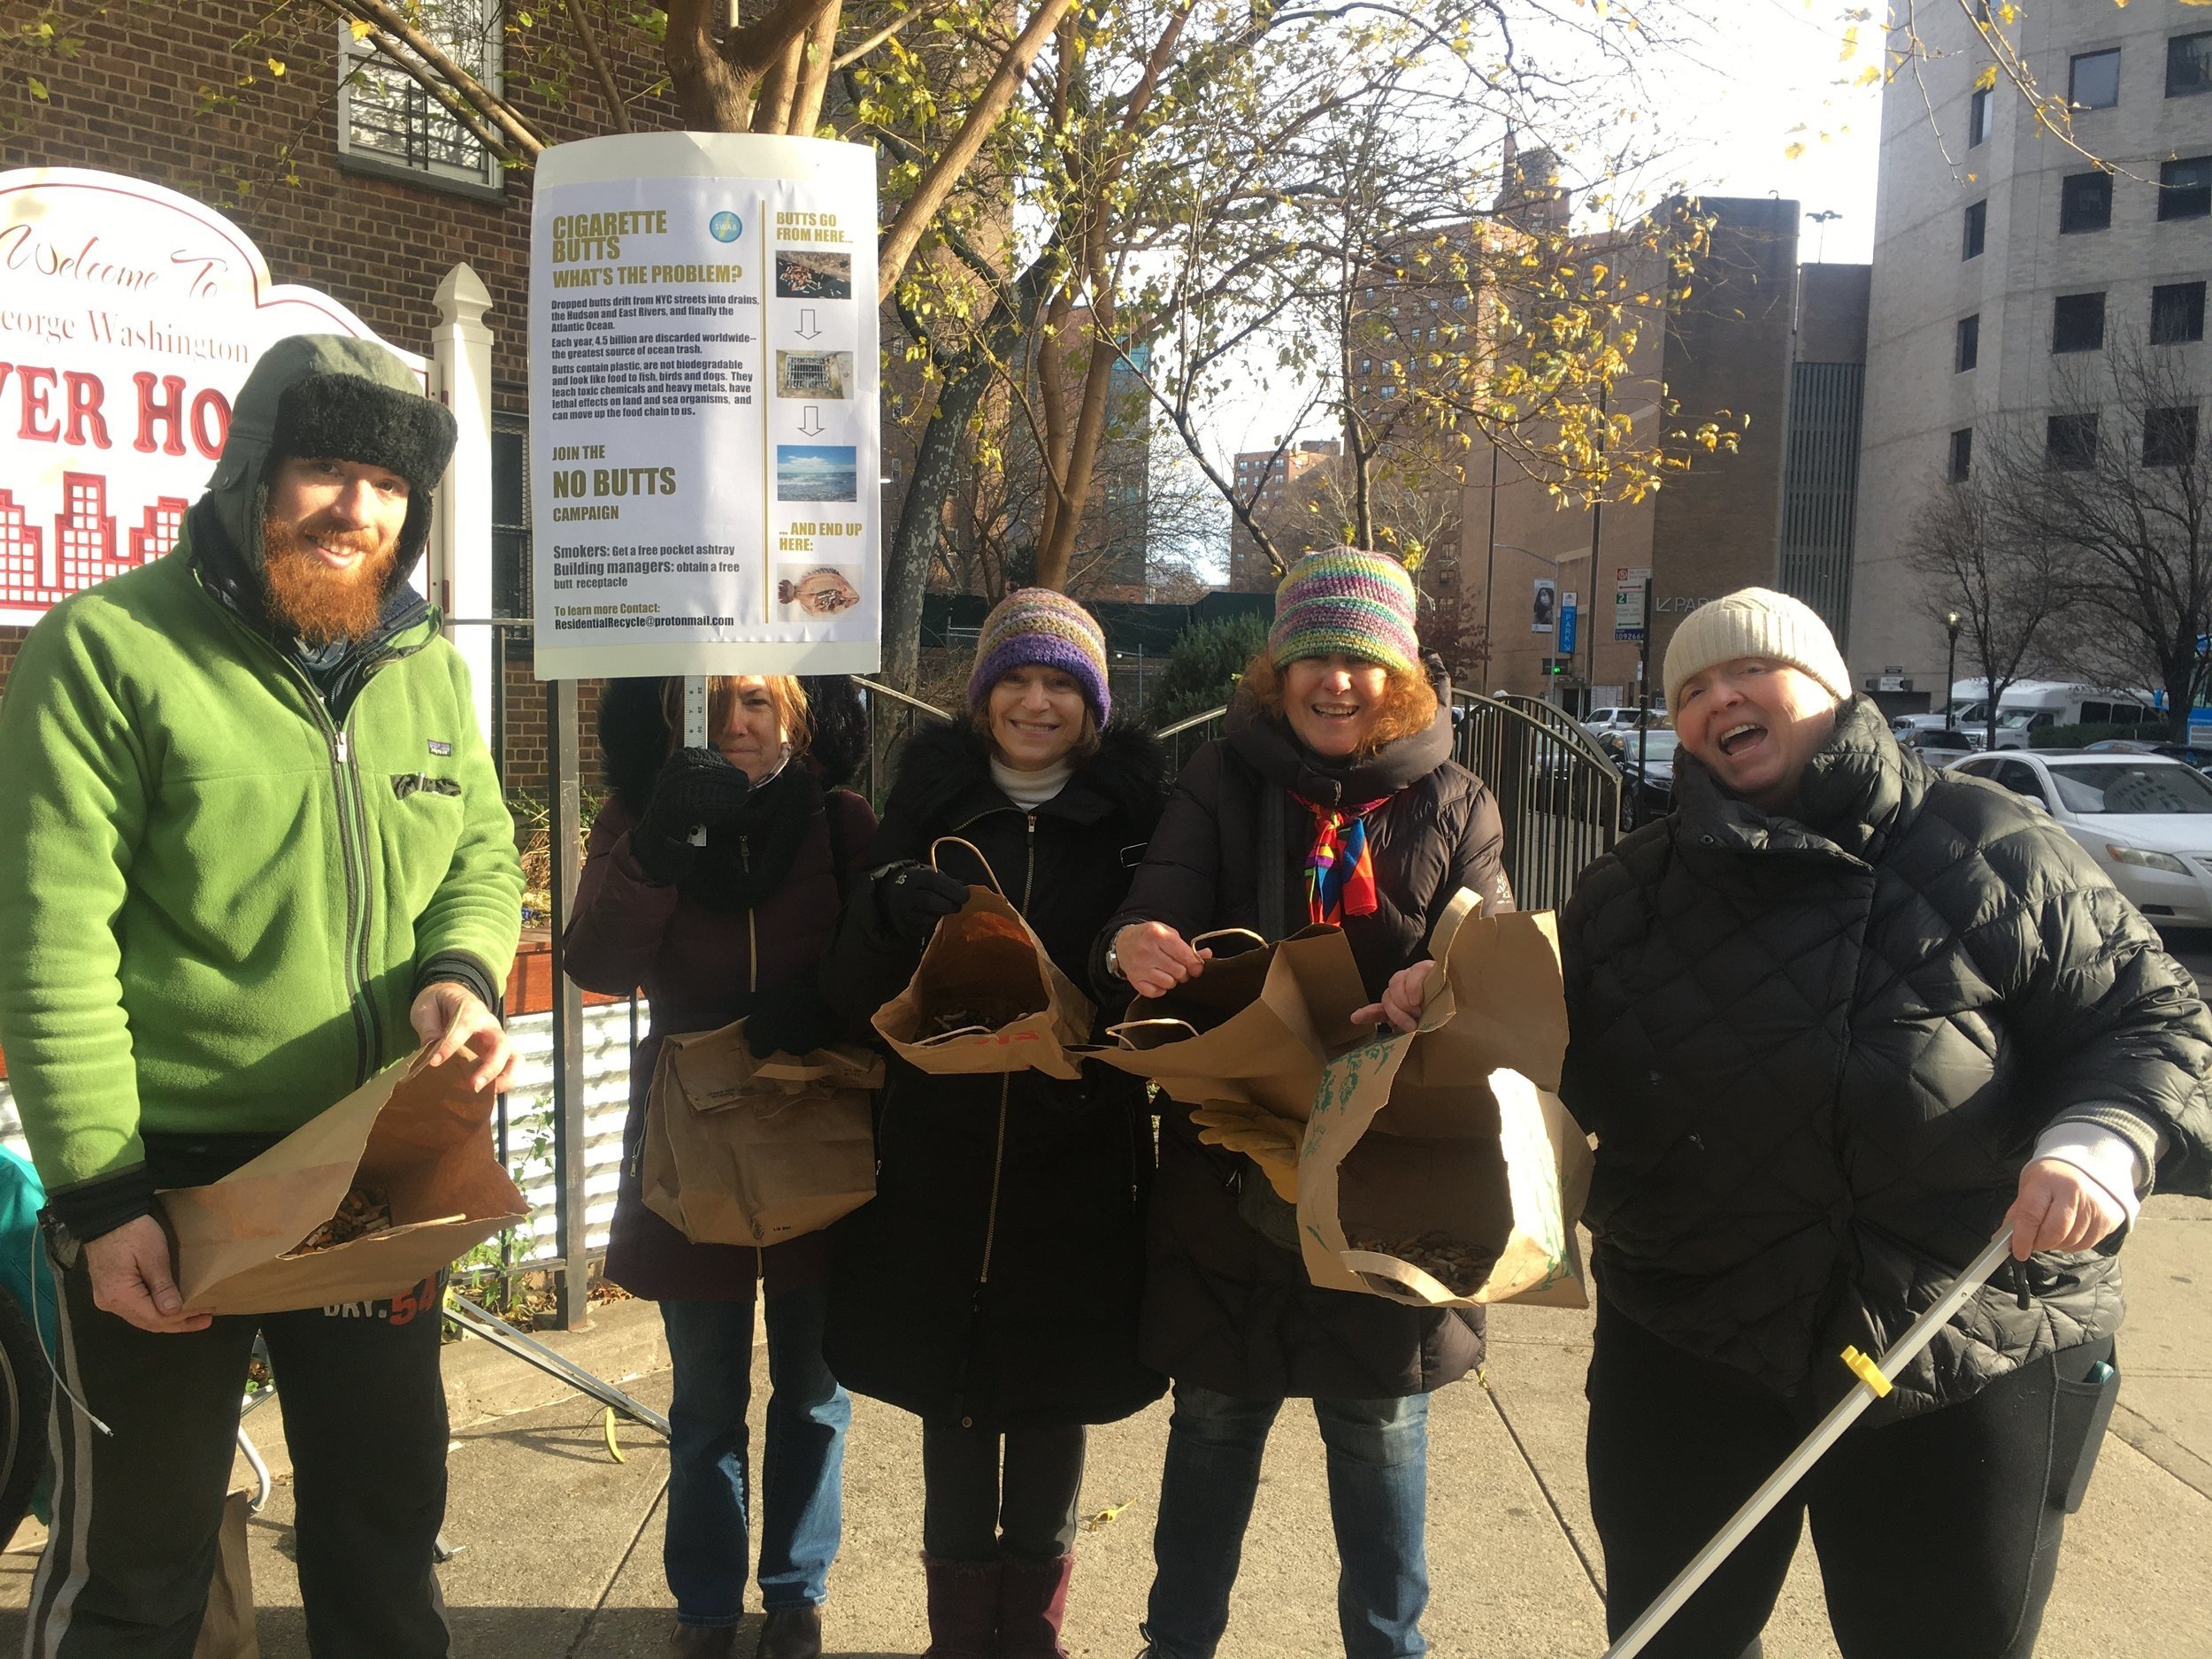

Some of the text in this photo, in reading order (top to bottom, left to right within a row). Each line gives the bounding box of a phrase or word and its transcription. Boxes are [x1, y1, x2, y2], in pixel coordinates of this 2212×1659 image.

[553, 211, 667, 239] CIGARETTE
[777, 212, 836, 227] BUTTS GO
[777, 227, 853, 243] FROM HERE...
[552, 236, 620, 263] BUTTS
[0, 225, 227, 298] Welcome To
[553, 265, 742, 288] WHAT'S THE PROBLEM?
[552, 299, 587, 309] Dropped
[589, 298, 611, 307] butts
[613, 296, 631, 306] drift
[656, 295, 672, 304] NYC
[708, 295, 726, 303] into
[728, 295, 759, 304] drains,
[552, 311, 565, 320] the
[567, 311, 599, 319] Hudson
[602, 309, 617, 318] and
[619, 308, 636, 317] East
[639, 307, 668, 316] Rivers,
[688, 306, 717, 316] finally
[552, 321, 615, 332] Atlantic Ocean.
[87, 311, 248, 363] Washington
[552, 338, 572, 347] Each
[573, 338, 594, 347] year,
[595, 336, 608, 345] 4.5
[610, 335, 637, 344] billion
[656, 334, 700, 342] discarded
[568, 349, 603, 359] greatest
[637, 346, 645, 355] of
[648, 346, 674, 355] ocean
[552, 365, 574, 374] Butts
[577, 363, 608, 373] contain
[611, 362, 641, 372] plastic,
[677, 360, 742, 369] biodegradable
[570, 375, 588, 385] look
[590, 374, 605, 383] like
[608, 373, 626, 382] food
[639, 373, 657, 381] fish,
[659, 372, 682, 380] birds
[703, 372, 727, 381] dogs.
[731, 372, 752, 381] They
[552, 388, 575, 396] leach
[601, 384, 645, 395] chemicals
[644, 383, 664, 393] and
[666, 383, 692, 392] heavy
[695, 383, 727, 392] metals,
[729, 383, 750, 392] have
[552, 399, 577, 408] lethal
[579, 398, 608, 407] effects
[623, 396, 641, 405] land
[644, 396, 660, 404] and
[680, 395, 730, 404] organisms,
[570, 411, 592, 419] move
[607, 409, 621, 418] the
[623, 408, 642, 417] food
[644, 407, 669, 416] chain
[552, 445, 605, 460] JOIN THE
[554, 467, 676, 498] NO BUTTS
[553, 506, 618, 522] CAMPAIGN
[791, 522, 816, 535] AND
[819, 523, 842, 535] END
[846, 523, 862, 535] UP
[780, 538, 813, 550] HERE:
[554, 545, 610, 558] Smokers:
[612, 546, 628, 556] Get
[639, 546, 657, 556] free
[660, 545, 694, 556] pocket
[696, 545, 734, 556] ashtray
[554, 562, 604, 576] Building
[608, 562, 674, 574] managers:
[677, 563, 708, 572] obtain
[719, 562, 739, 572] free
[554, 577, 627, 589] butt receptacle
[1618, 593, 1625, 603] 2
[1675, 597, 1714, 612] PAR
[555, 603, 660, 616] To learn more Contact:
[556, 616, 733, 630] ResidentialRecycle@protonmail.com
